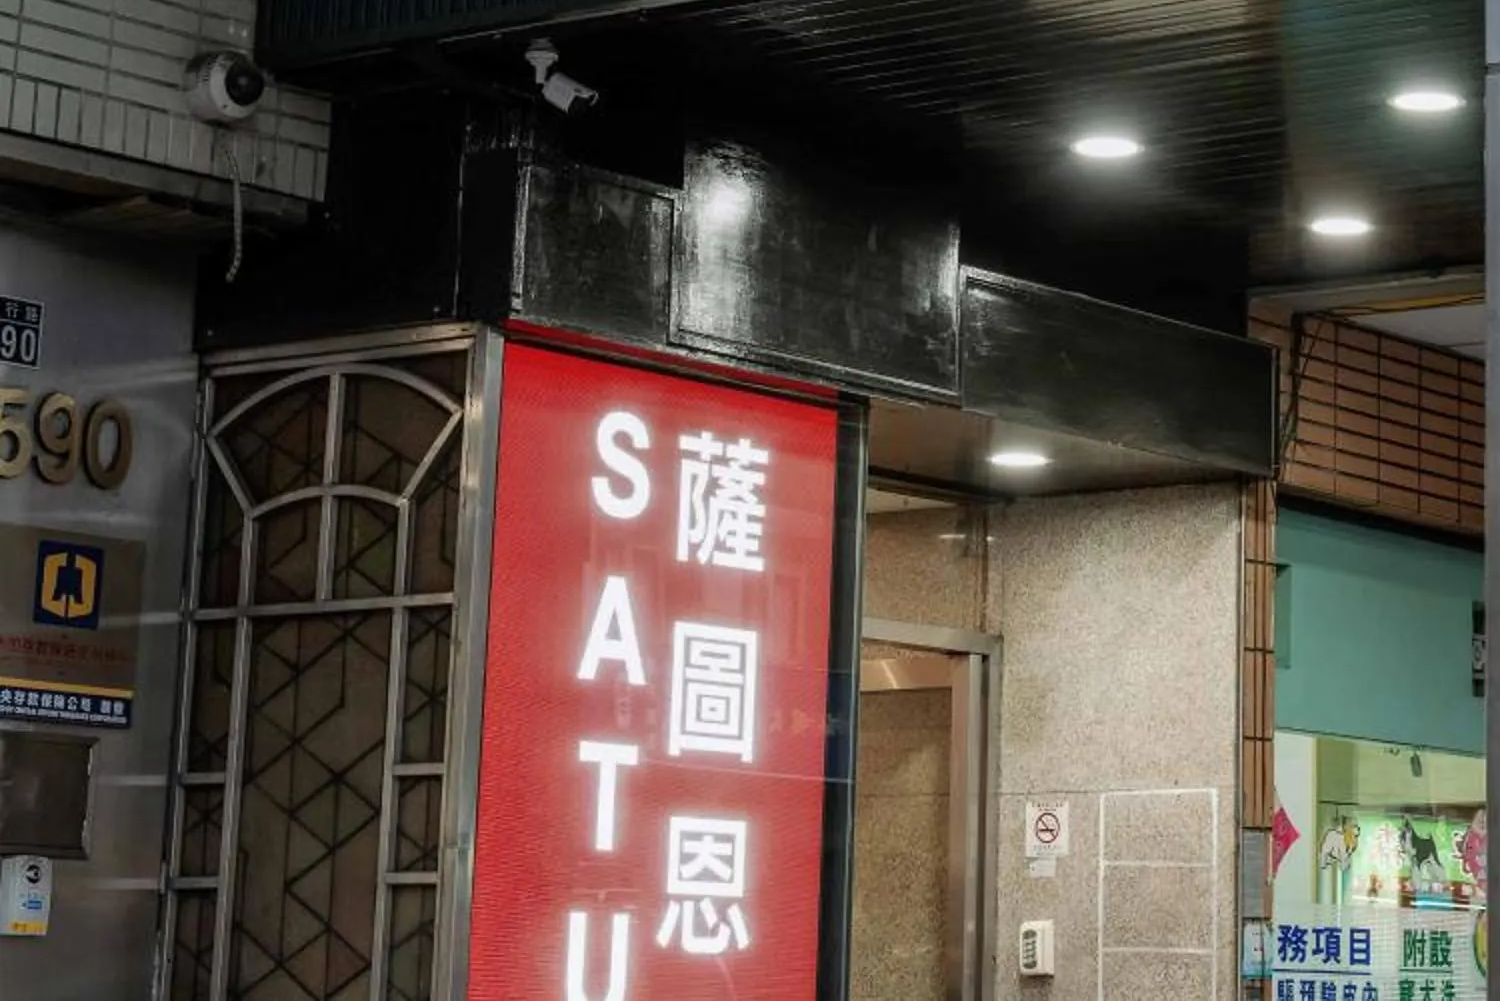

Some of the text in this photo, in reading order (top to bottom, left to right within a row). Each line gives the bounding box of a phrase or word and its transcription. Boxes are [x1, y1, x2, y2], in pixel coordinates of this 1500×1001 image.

[655, 430, 770, 956] 薩圖恩
[1277, 925, 1372, 966] 務項目
[1403, 929, 1453, 967] 附設
